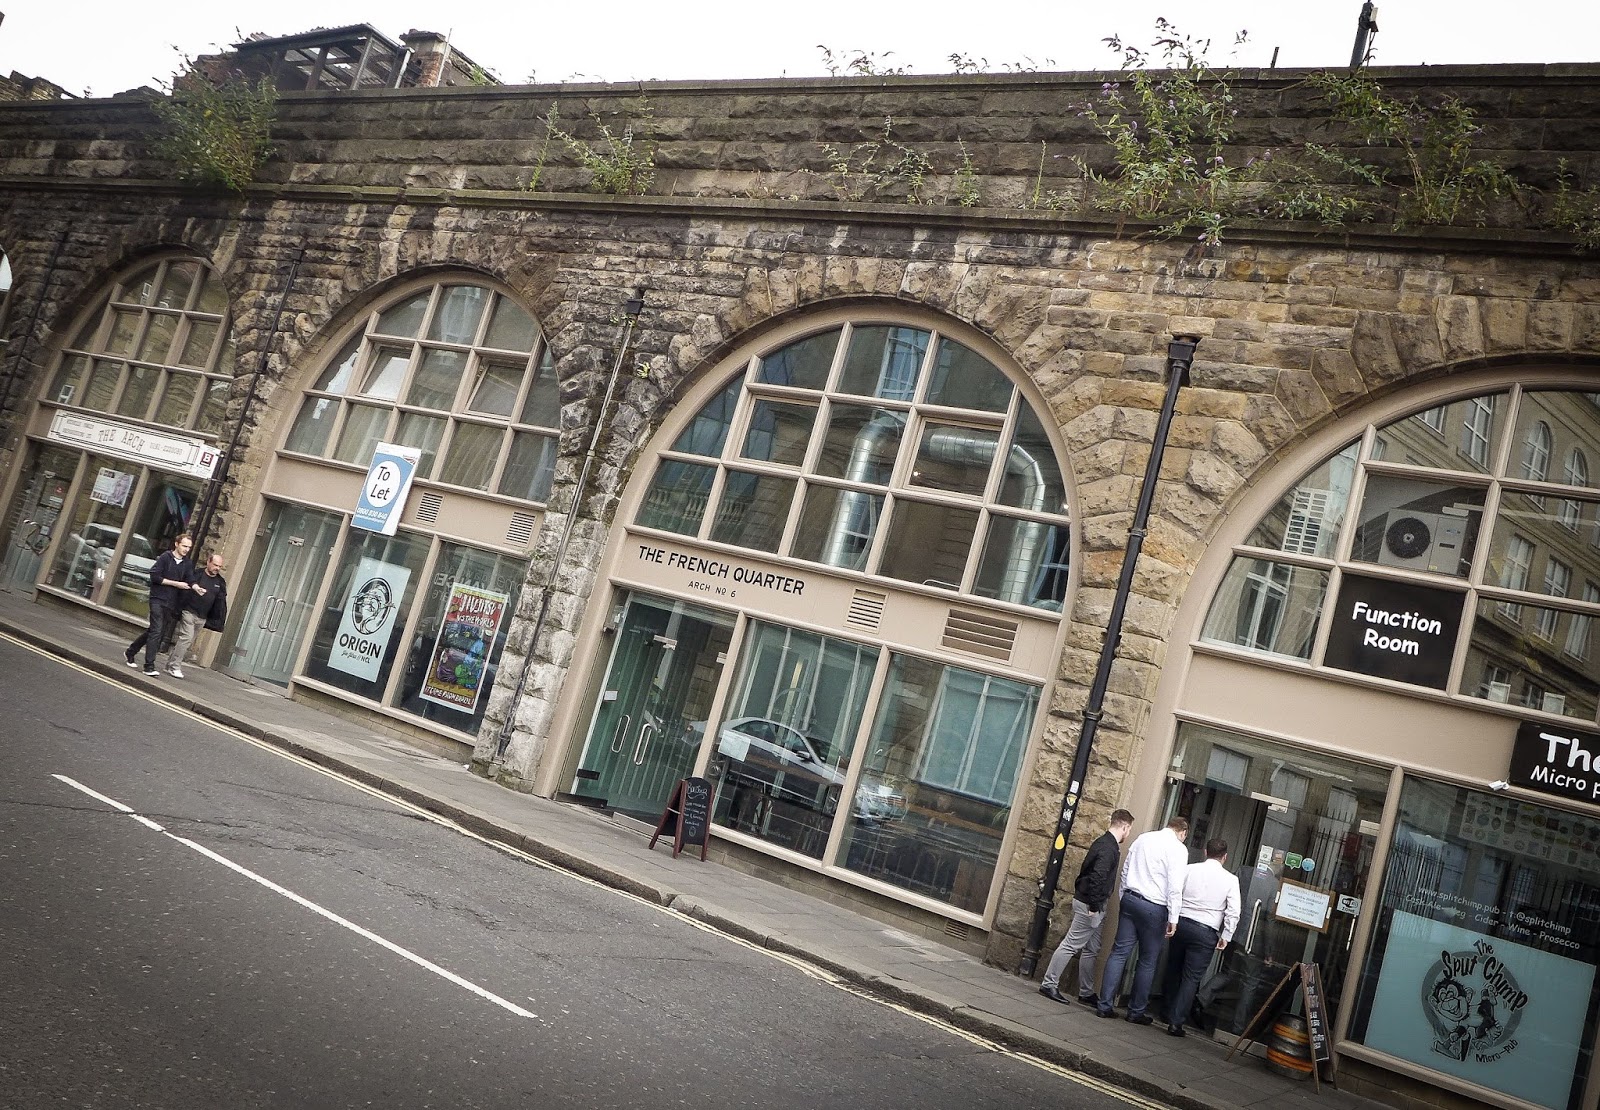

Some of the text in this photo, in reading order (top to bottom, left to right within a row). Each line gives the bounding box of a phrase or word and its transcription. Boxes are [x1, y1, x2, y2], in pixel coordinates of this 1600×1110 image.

[99, 429, 117, 442] THE
[121, 430, 145, 452] ARCH
[377, 466, 391, 481] To
[370, 484, 390, 501] Let
[638, 545, 805, 596] THE FRENCH QUARTER
[688, 580, 711, 592] ARCH
[730, 590, 737, 598] 6
[1352, 601, 1442, 635] Function
[339, 633, 382, 659] ORIGIN
[1363, 628, 1420, 656] Room
[1270, 758, 1286, 782] 7
[1530, 765, 1587, 791] Micro
[1418, 886, 1500, 915] www.splitchimp.pub
[1474, 913, 1499, 926] Cider
[1508, 922, 1531, 936] Wine
[1539, 931, 1580, 950] Prosecco
[1473, 938, 1494, 956] The
[1483, 956, 1529, 1013] Chimp
